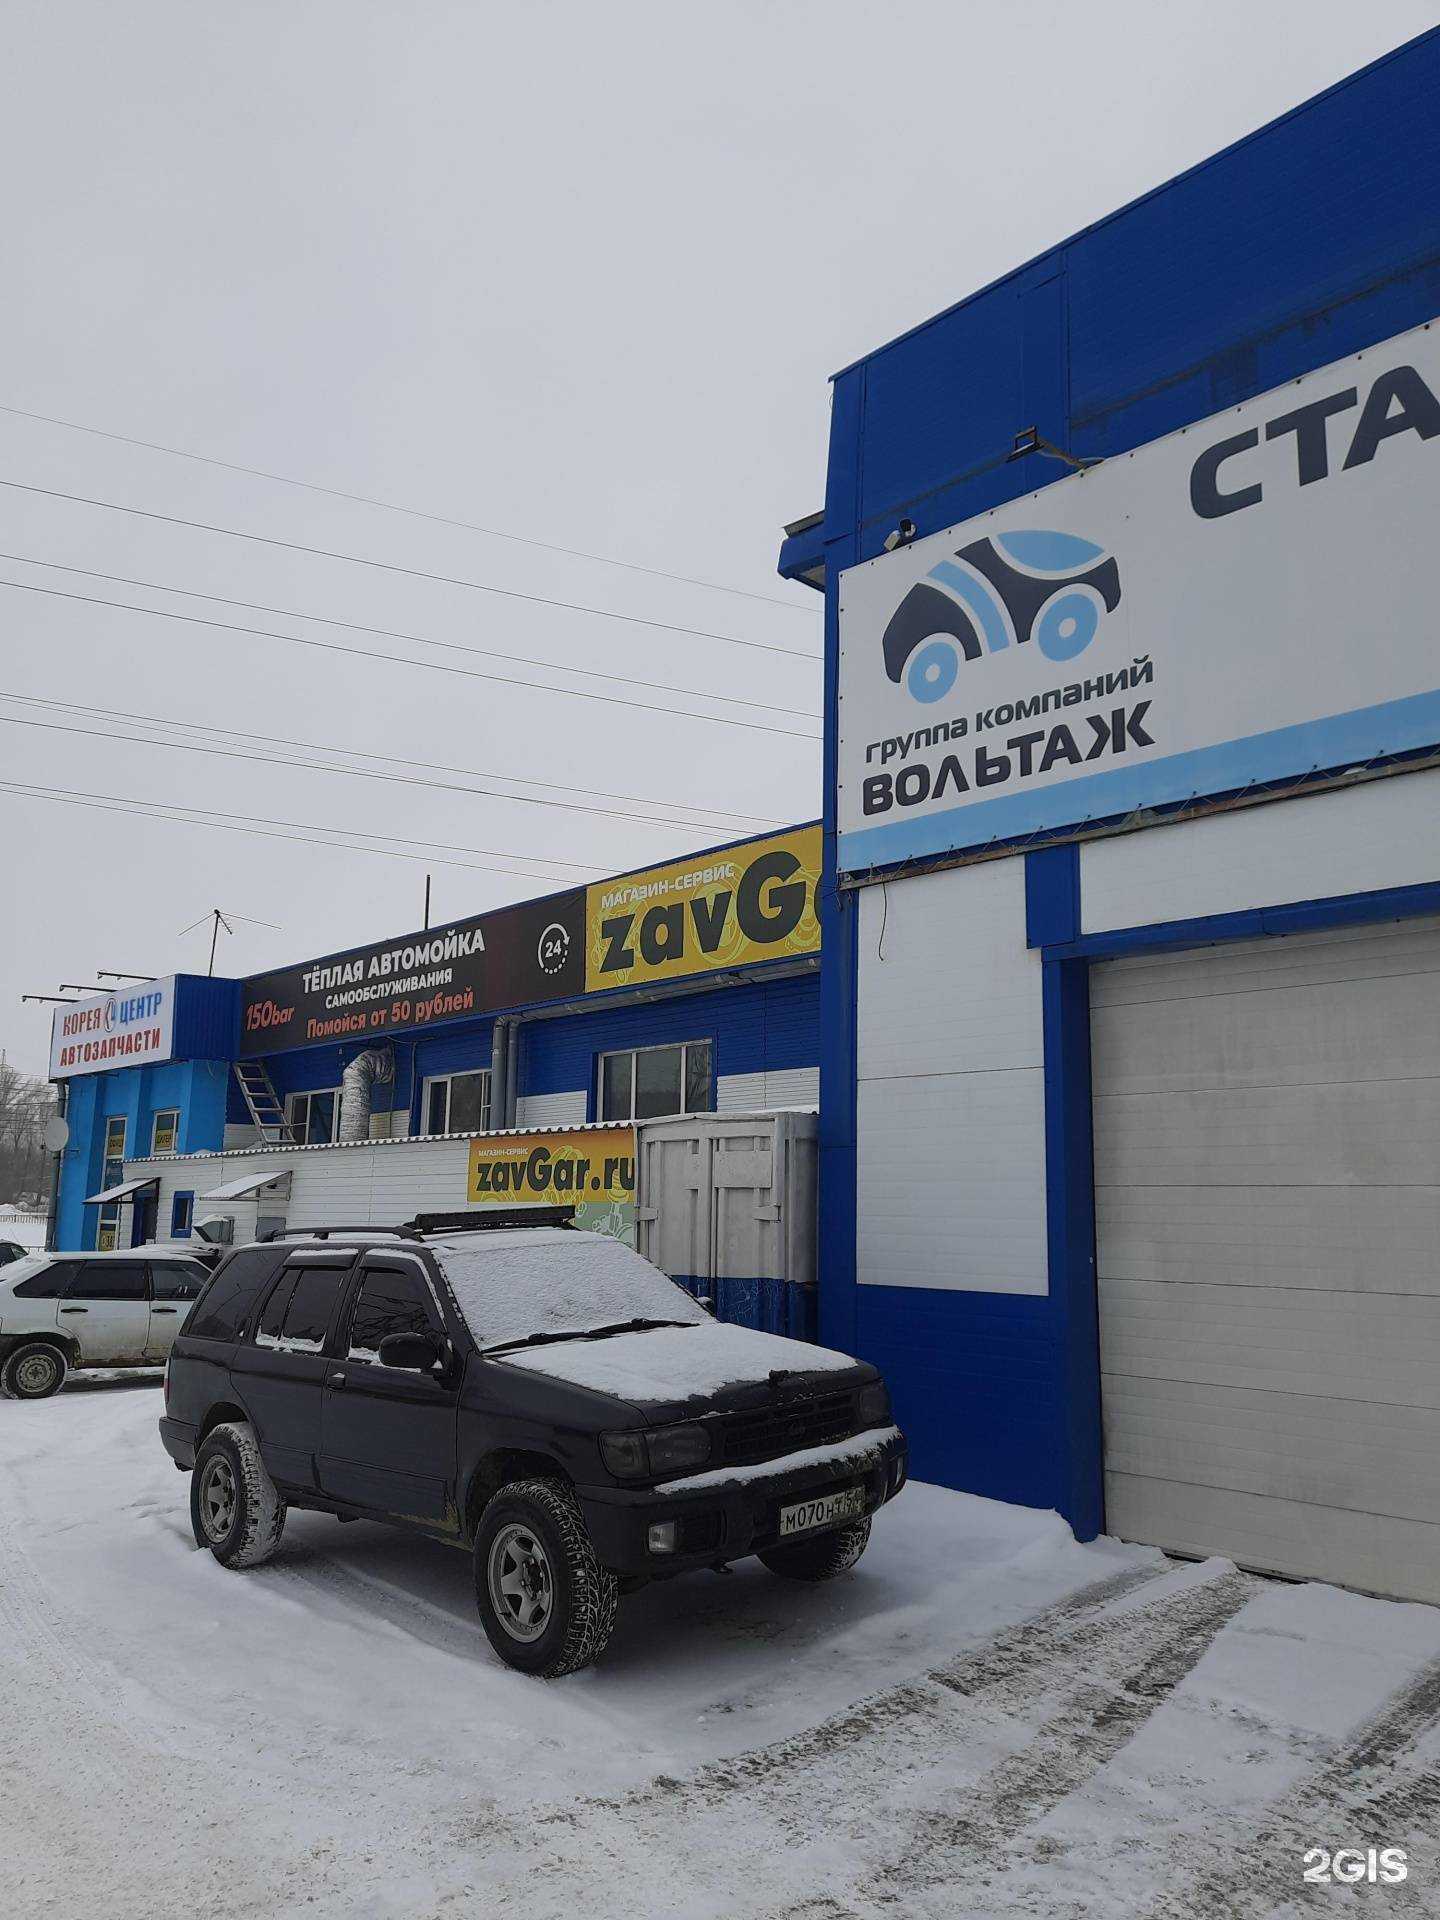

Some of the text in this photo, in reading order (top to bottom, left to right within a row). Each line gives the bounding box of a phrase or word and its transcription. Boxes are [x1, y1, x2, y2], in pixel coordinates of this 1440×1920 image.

[1190, 365, 1440, 519] СТА
[866, 654, 1154, 765] группа компаний
[863, 700, 1156, 816] ВОЛЬТАЖ
[601, 864, 736, 909] МАГАЗИН-СЕРВИС
[599, 851, 821, 974] zavG
[302, 928, 486, 994] ТЁПЛАЯ АВТОМОЙКА
[545, 939, 562, 958] 24
[306, 985, 474, 1039] Помойся от 50 рублей
[325, 967, 453, 1010] САМООБСЛУЖИВАНИЯ
[63, 992, 162, 1036] КОРЕЯ ЦЕНТР
[60, 1027, 161, 1066] АВТОЗАПЧАСТИ
[476, 1147, 635, 1192] zavGar.ru
